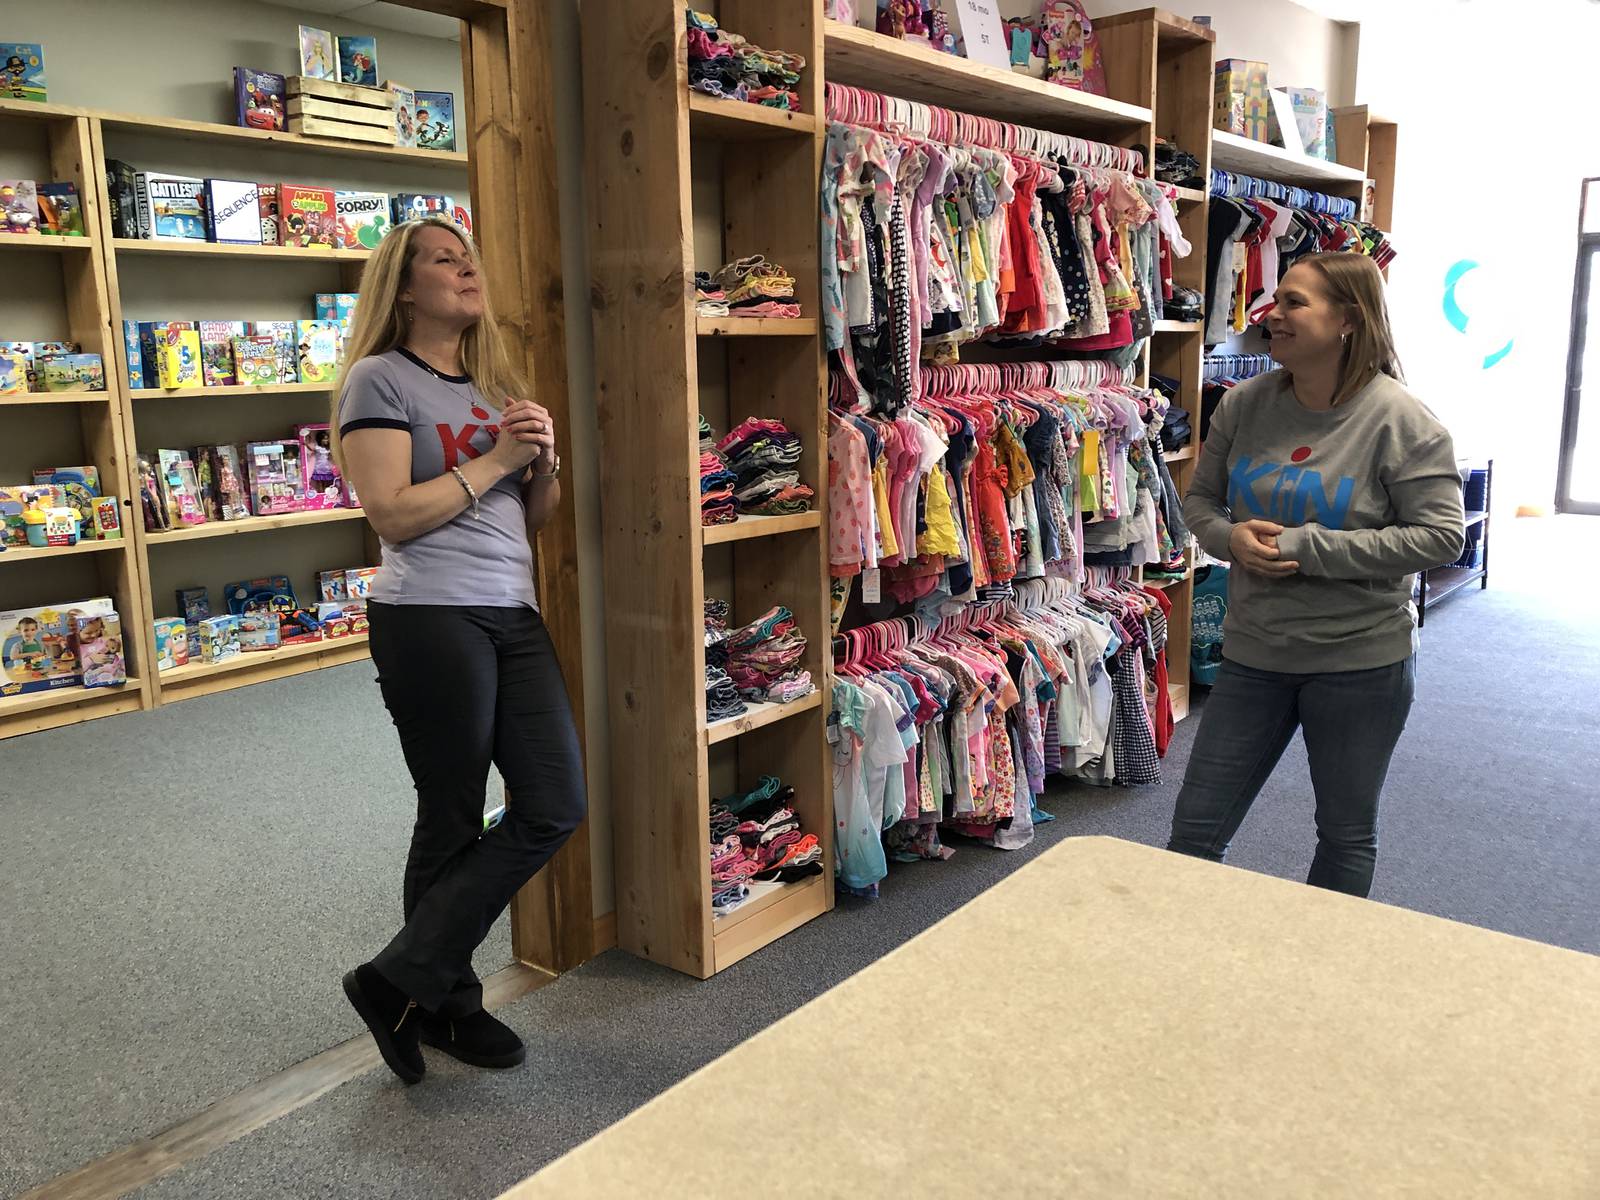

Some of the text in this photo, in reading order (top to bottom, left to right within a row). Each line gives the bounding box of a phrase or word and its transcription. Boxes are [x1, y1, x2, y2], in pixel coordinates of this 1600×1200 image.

[295, 191, 324, 202] APPLES
[134, 175, 151, 231] BATTLESHIP
[213, 188, 259, 225] SEQUENCE
[336, 198, 384, 214] SORRY!
[412, 195, 443, 212] CLUE
[201, 320, 233, 332] CANDY
[271, 322, 294, 330] SEQUE
[200, 332, 226, 342] LAND
[49, 677, 76, 687] Kitchen
